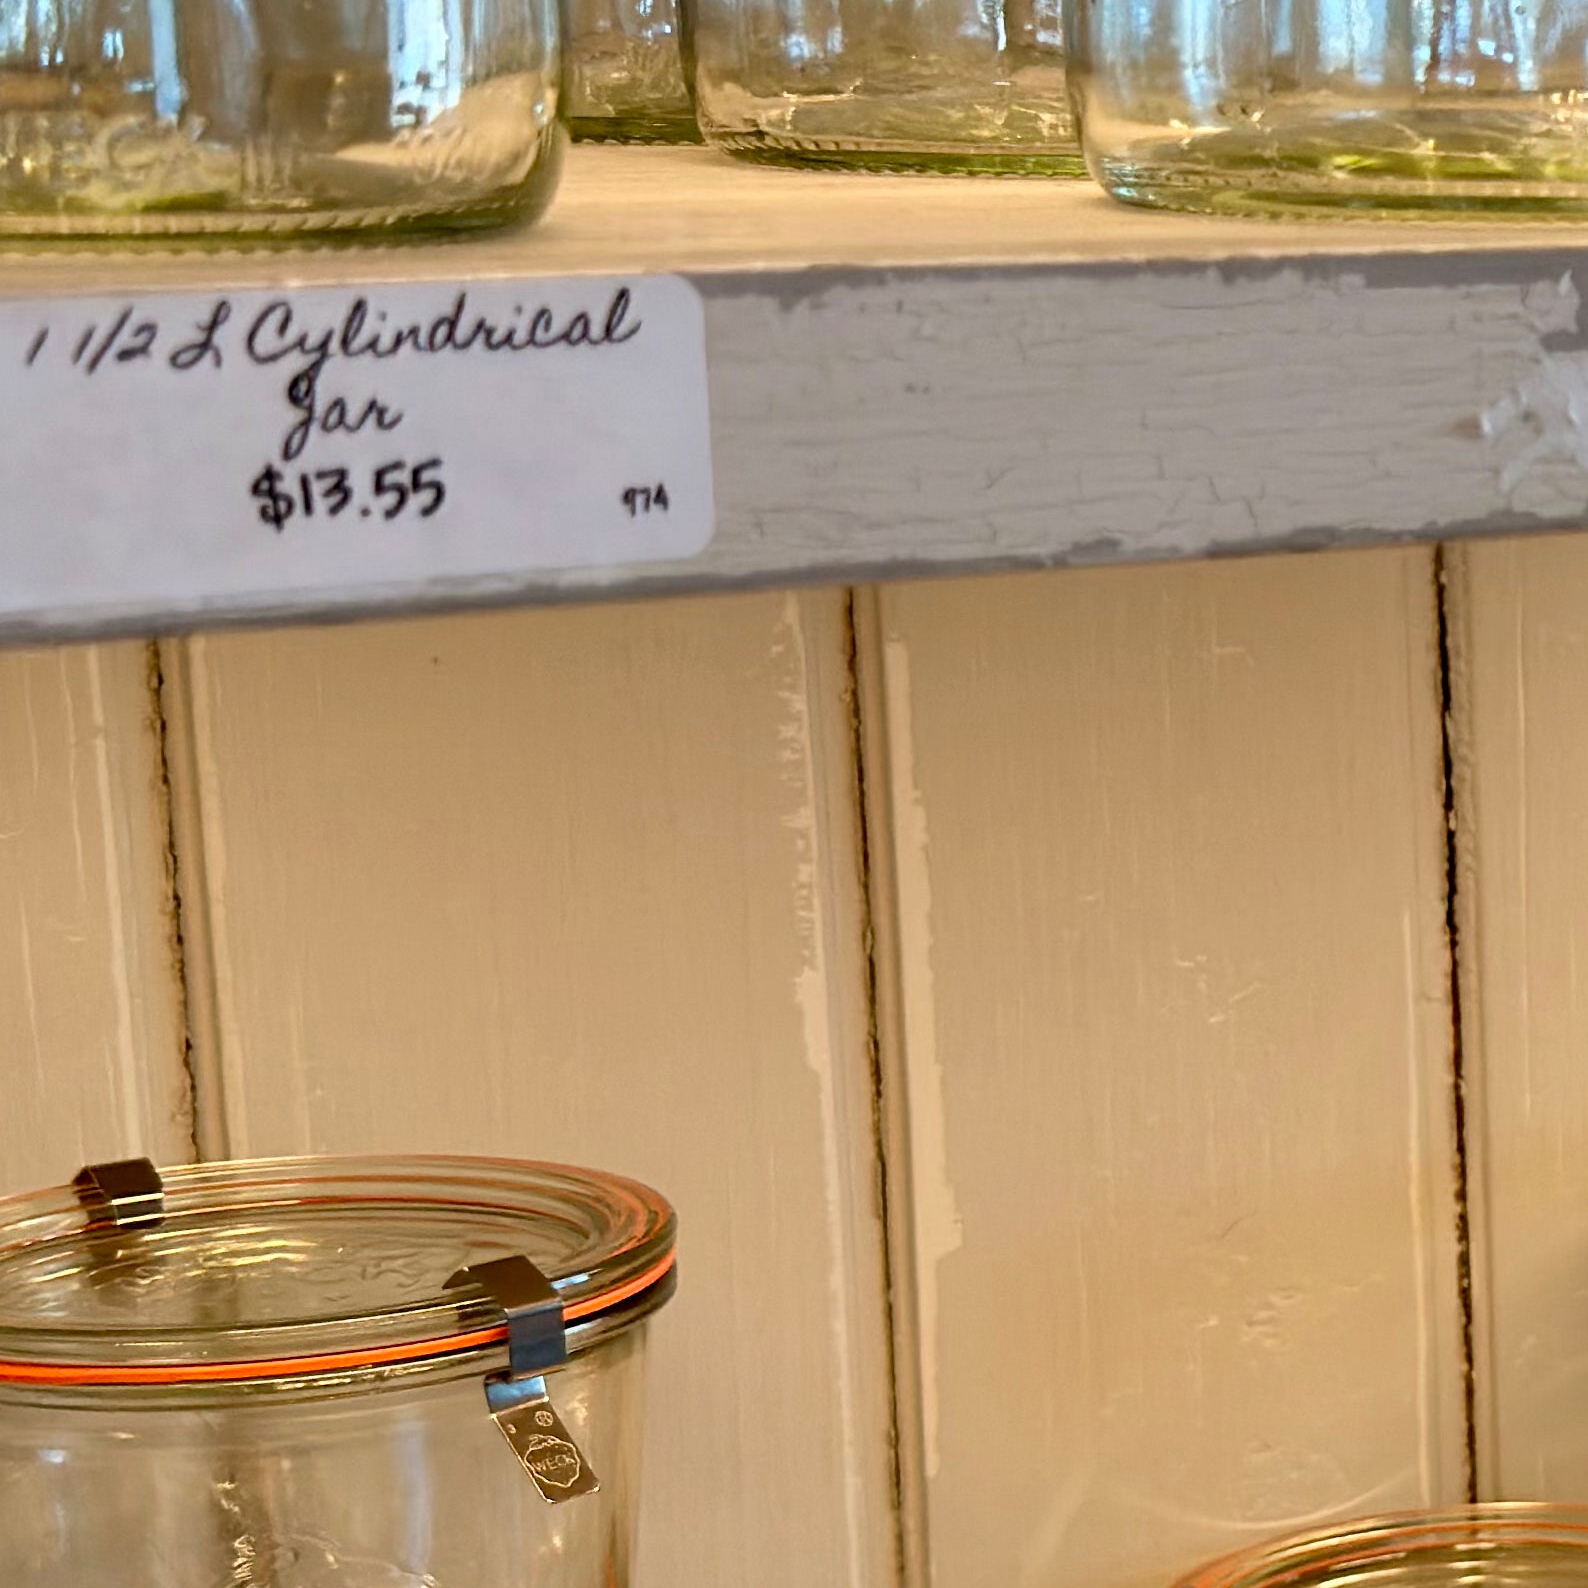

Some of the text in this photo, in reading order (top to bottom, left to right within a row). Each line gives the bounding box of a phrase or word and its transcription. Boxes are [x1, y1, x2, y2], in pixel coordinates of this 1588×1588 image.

[25, 287, 642, 397] 1 1/2 L Cylindrical
[282, 377, 404, 460] Jar
[251, 457, 447, 533] $13.55
